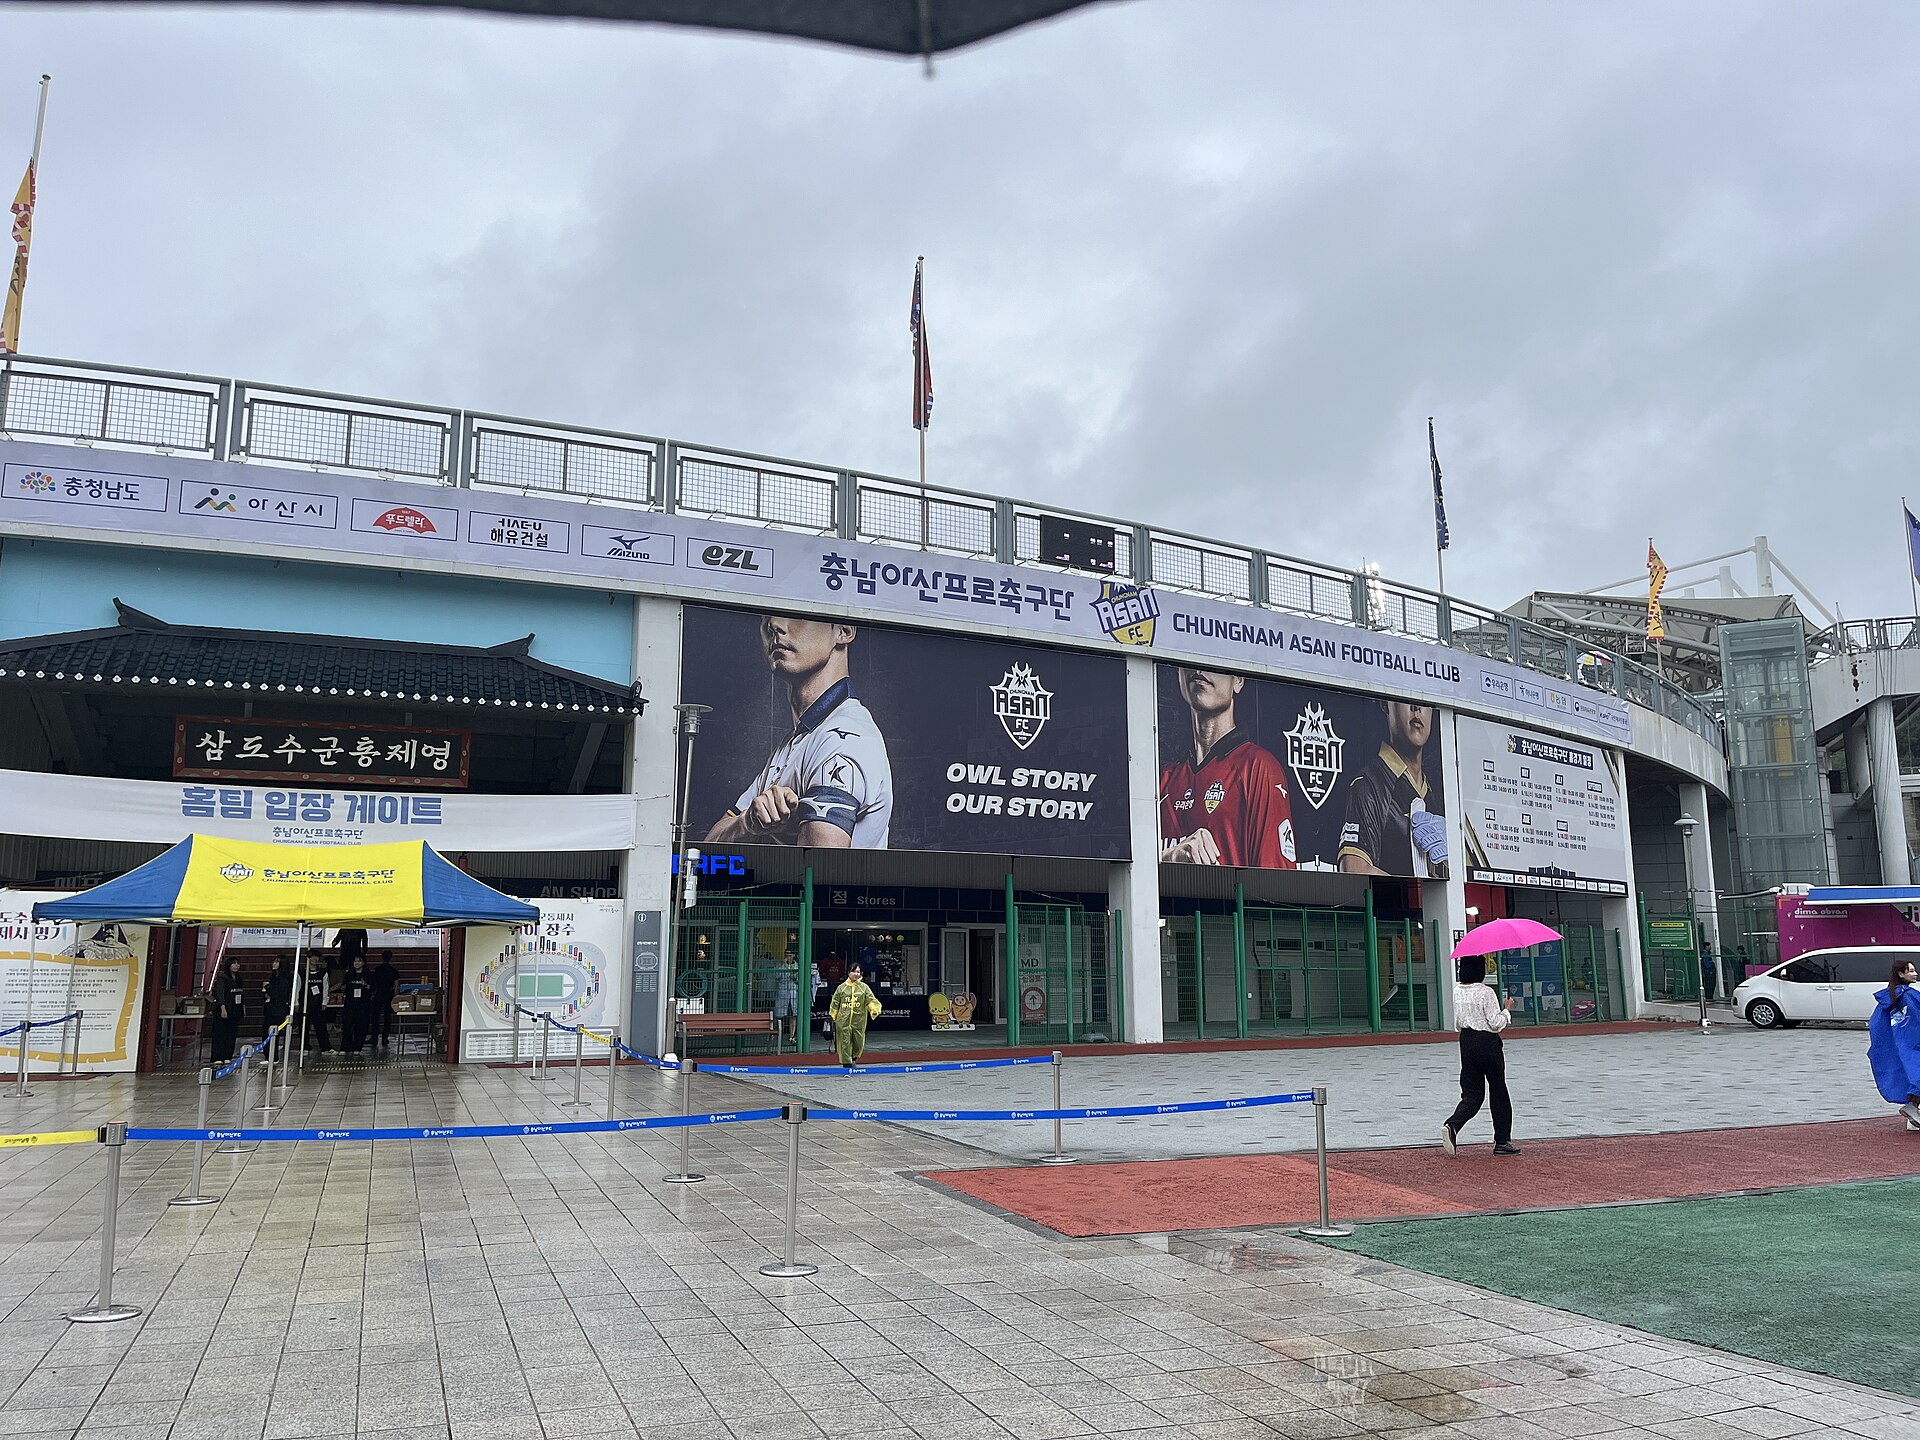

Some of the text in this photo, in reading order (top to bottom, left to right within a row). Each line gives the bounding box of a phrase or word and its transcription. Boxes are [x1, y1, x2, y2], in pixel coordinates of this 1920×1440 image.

[63, 477, 140, 501] 충청남도
[248, 498, 323, 519] 아산시
[385, 513, 425, 529] 푸드렐라
[490, 528, 548, 548] 해유건설
[820, 551, 1074, 622] 충남아산프로축구단
[1095, 588, 1158, 631] ASAN
[1128, 625, 1143, 640] FC
[1173, 612, 1460, 683] CHUNGNAM ASAN FOOTBALL CLUB
[996, 689, 1049, 717] ASAN
[1015, 718, 1029, 730] FC
[196, 729, 451, 771] 삼도수군통제영
[1290, 735, 1341, 770] ASAN
[946, 762, 1097, 792] OWL STORY
[1309, 771, 1323, 785] FC
[181, 786, 442, 825] 홈팀 입장 게이트
[946, 792, 1093, 821] OUR STORY
[273, 826, 363, 839] 충남아산프로축구단
[263, 869, 395, 880] 충남아산프로축구단
[833, 890, 847, 905] 점
[857, 894, 896, 906] Stores
[35, 926, 67, 941] 명기
[545, 923, 576, 936] 장수
[1021, 958, 1039, 968] MD
